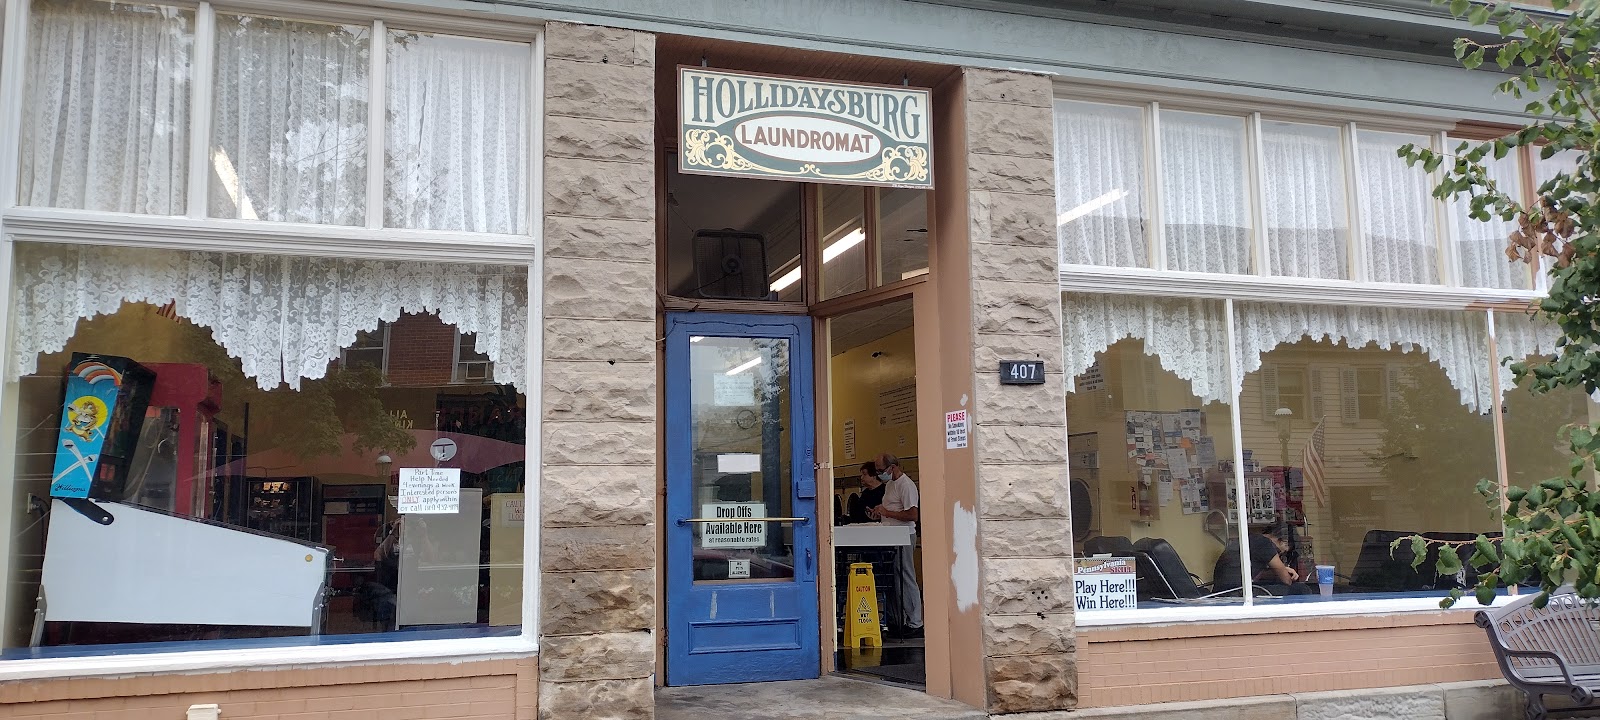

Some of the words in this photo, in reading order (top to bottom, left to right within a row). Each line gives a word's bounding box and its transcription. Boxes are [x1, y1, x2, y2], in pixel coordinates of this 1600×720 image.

[690, 75, 920, 140] HOLLIDAYSBURG
[740, 124, 874, 154] LAUNDROMAT
[1010, 363, 1036, 379] 407
[947, 411, 965, 423] PLEASE
[414, 468, 428, 476] Part
[410, 475, 425, 484] Help
[54, 483, 86, 493] Williams
[400, 488, 435, 497] Interested
[402, 496, 421, 504] ONLY
[410, 503, 423, 512] call
[716, 506, 735, 519] Drop
[736, 505, 752, 518] Offs
[705, 522, 742, 535] Available
[743, 522, 762, 534] Here
[1077, 558, 1127, 574] Pennsylvania
[1110, 566, 1132, 574] SKILL
[855, 585, 871, 593] CAUTION
[1075, 579, 1097, 596] Play
[1099, 579, 1135, 593] Here!!!
[1075, 595, 1097, 610] Win
[1099, 594, 1135, 609] Here!!!
